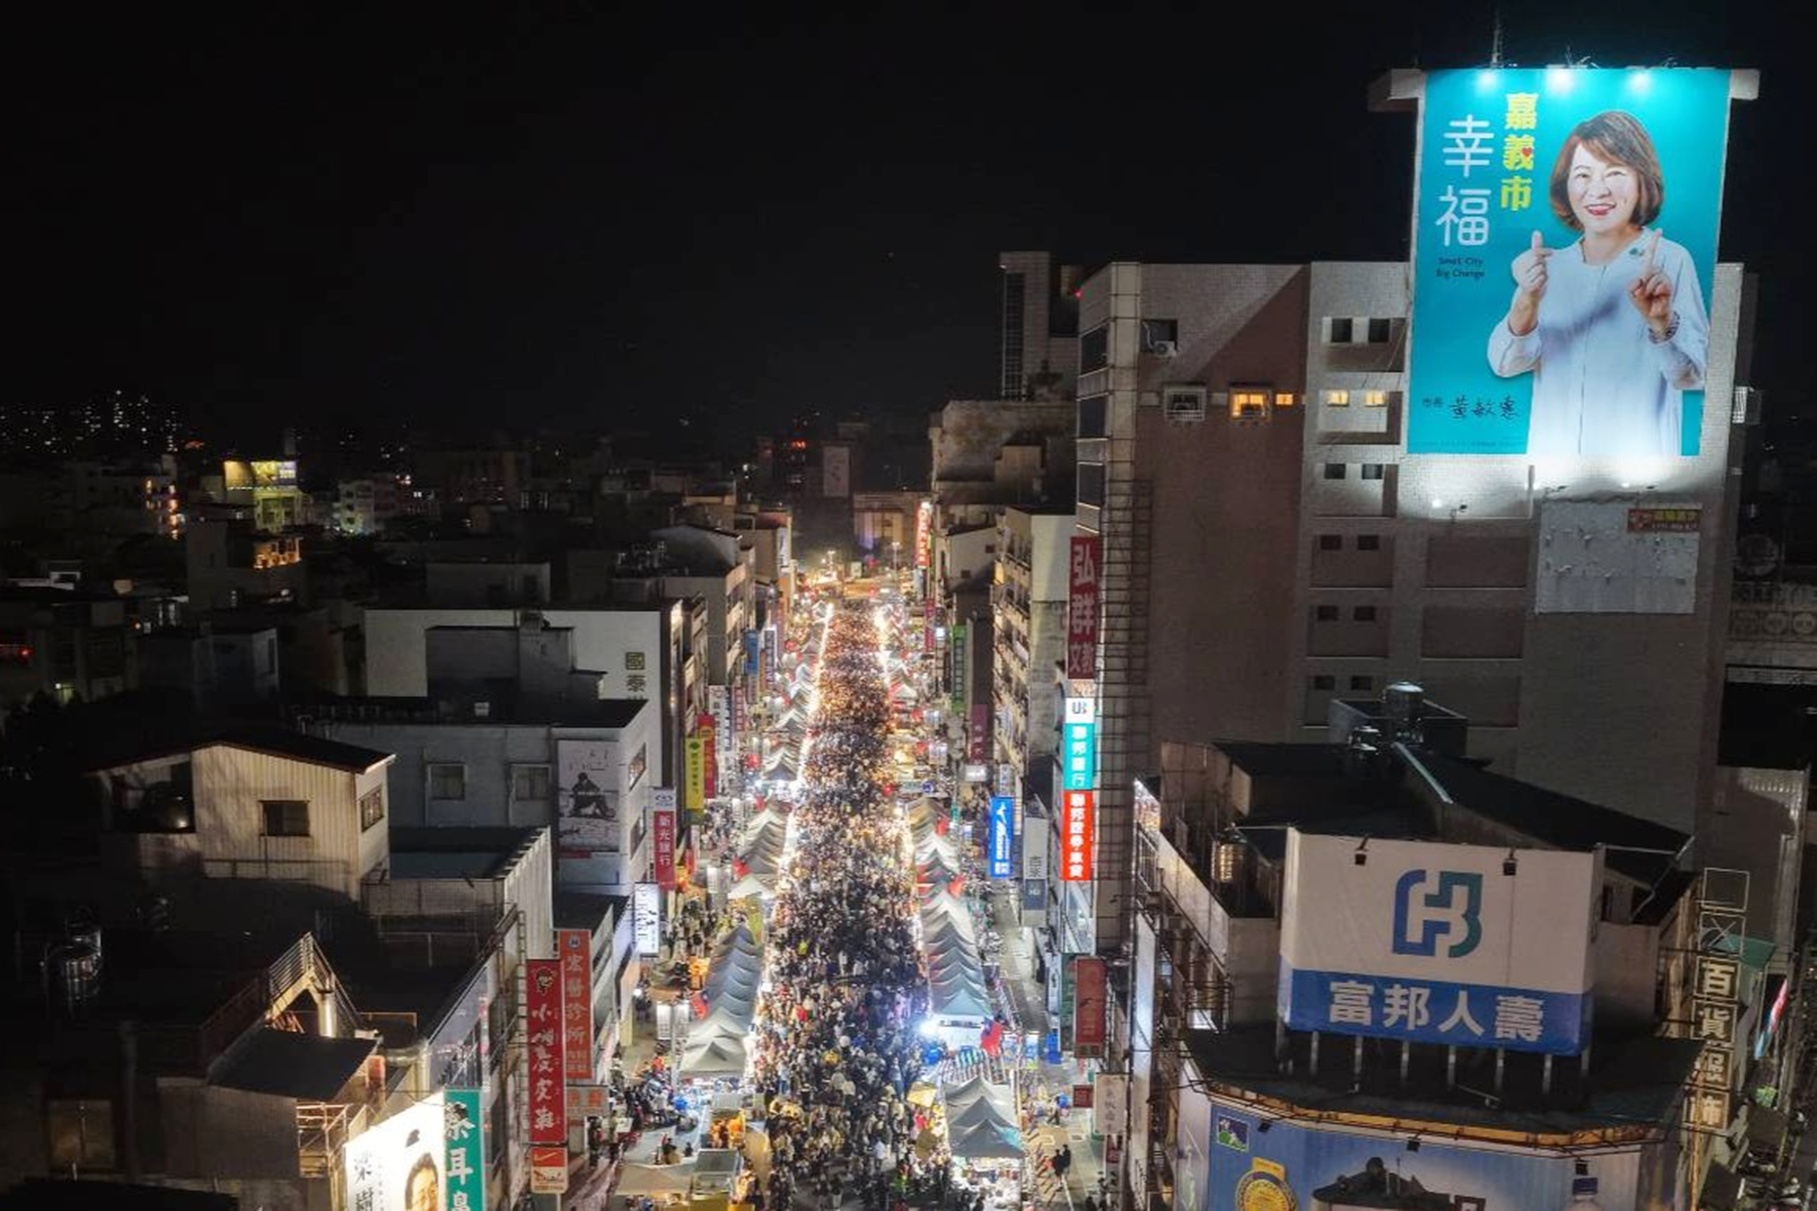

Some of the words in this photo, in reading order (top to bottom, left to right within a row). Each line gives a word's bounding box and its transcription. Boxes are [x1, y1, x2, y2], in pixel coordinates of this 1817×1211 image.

[1500, 92, 1539, 211] 嘉義市
[1435, 114, 1494, 247] 幸福
[1436, 268, 1450, 279] Big
[1452, 269, 1485, 280] Change
[1465, 256, 1483, 267] City
[1071, 543, 1095, 636] 弘群
[625, 651, 646, 700] 國泰
[1069, 642, 1094, 674] 文教
[1329, 980, 1544, 1043] 富邦人壽
